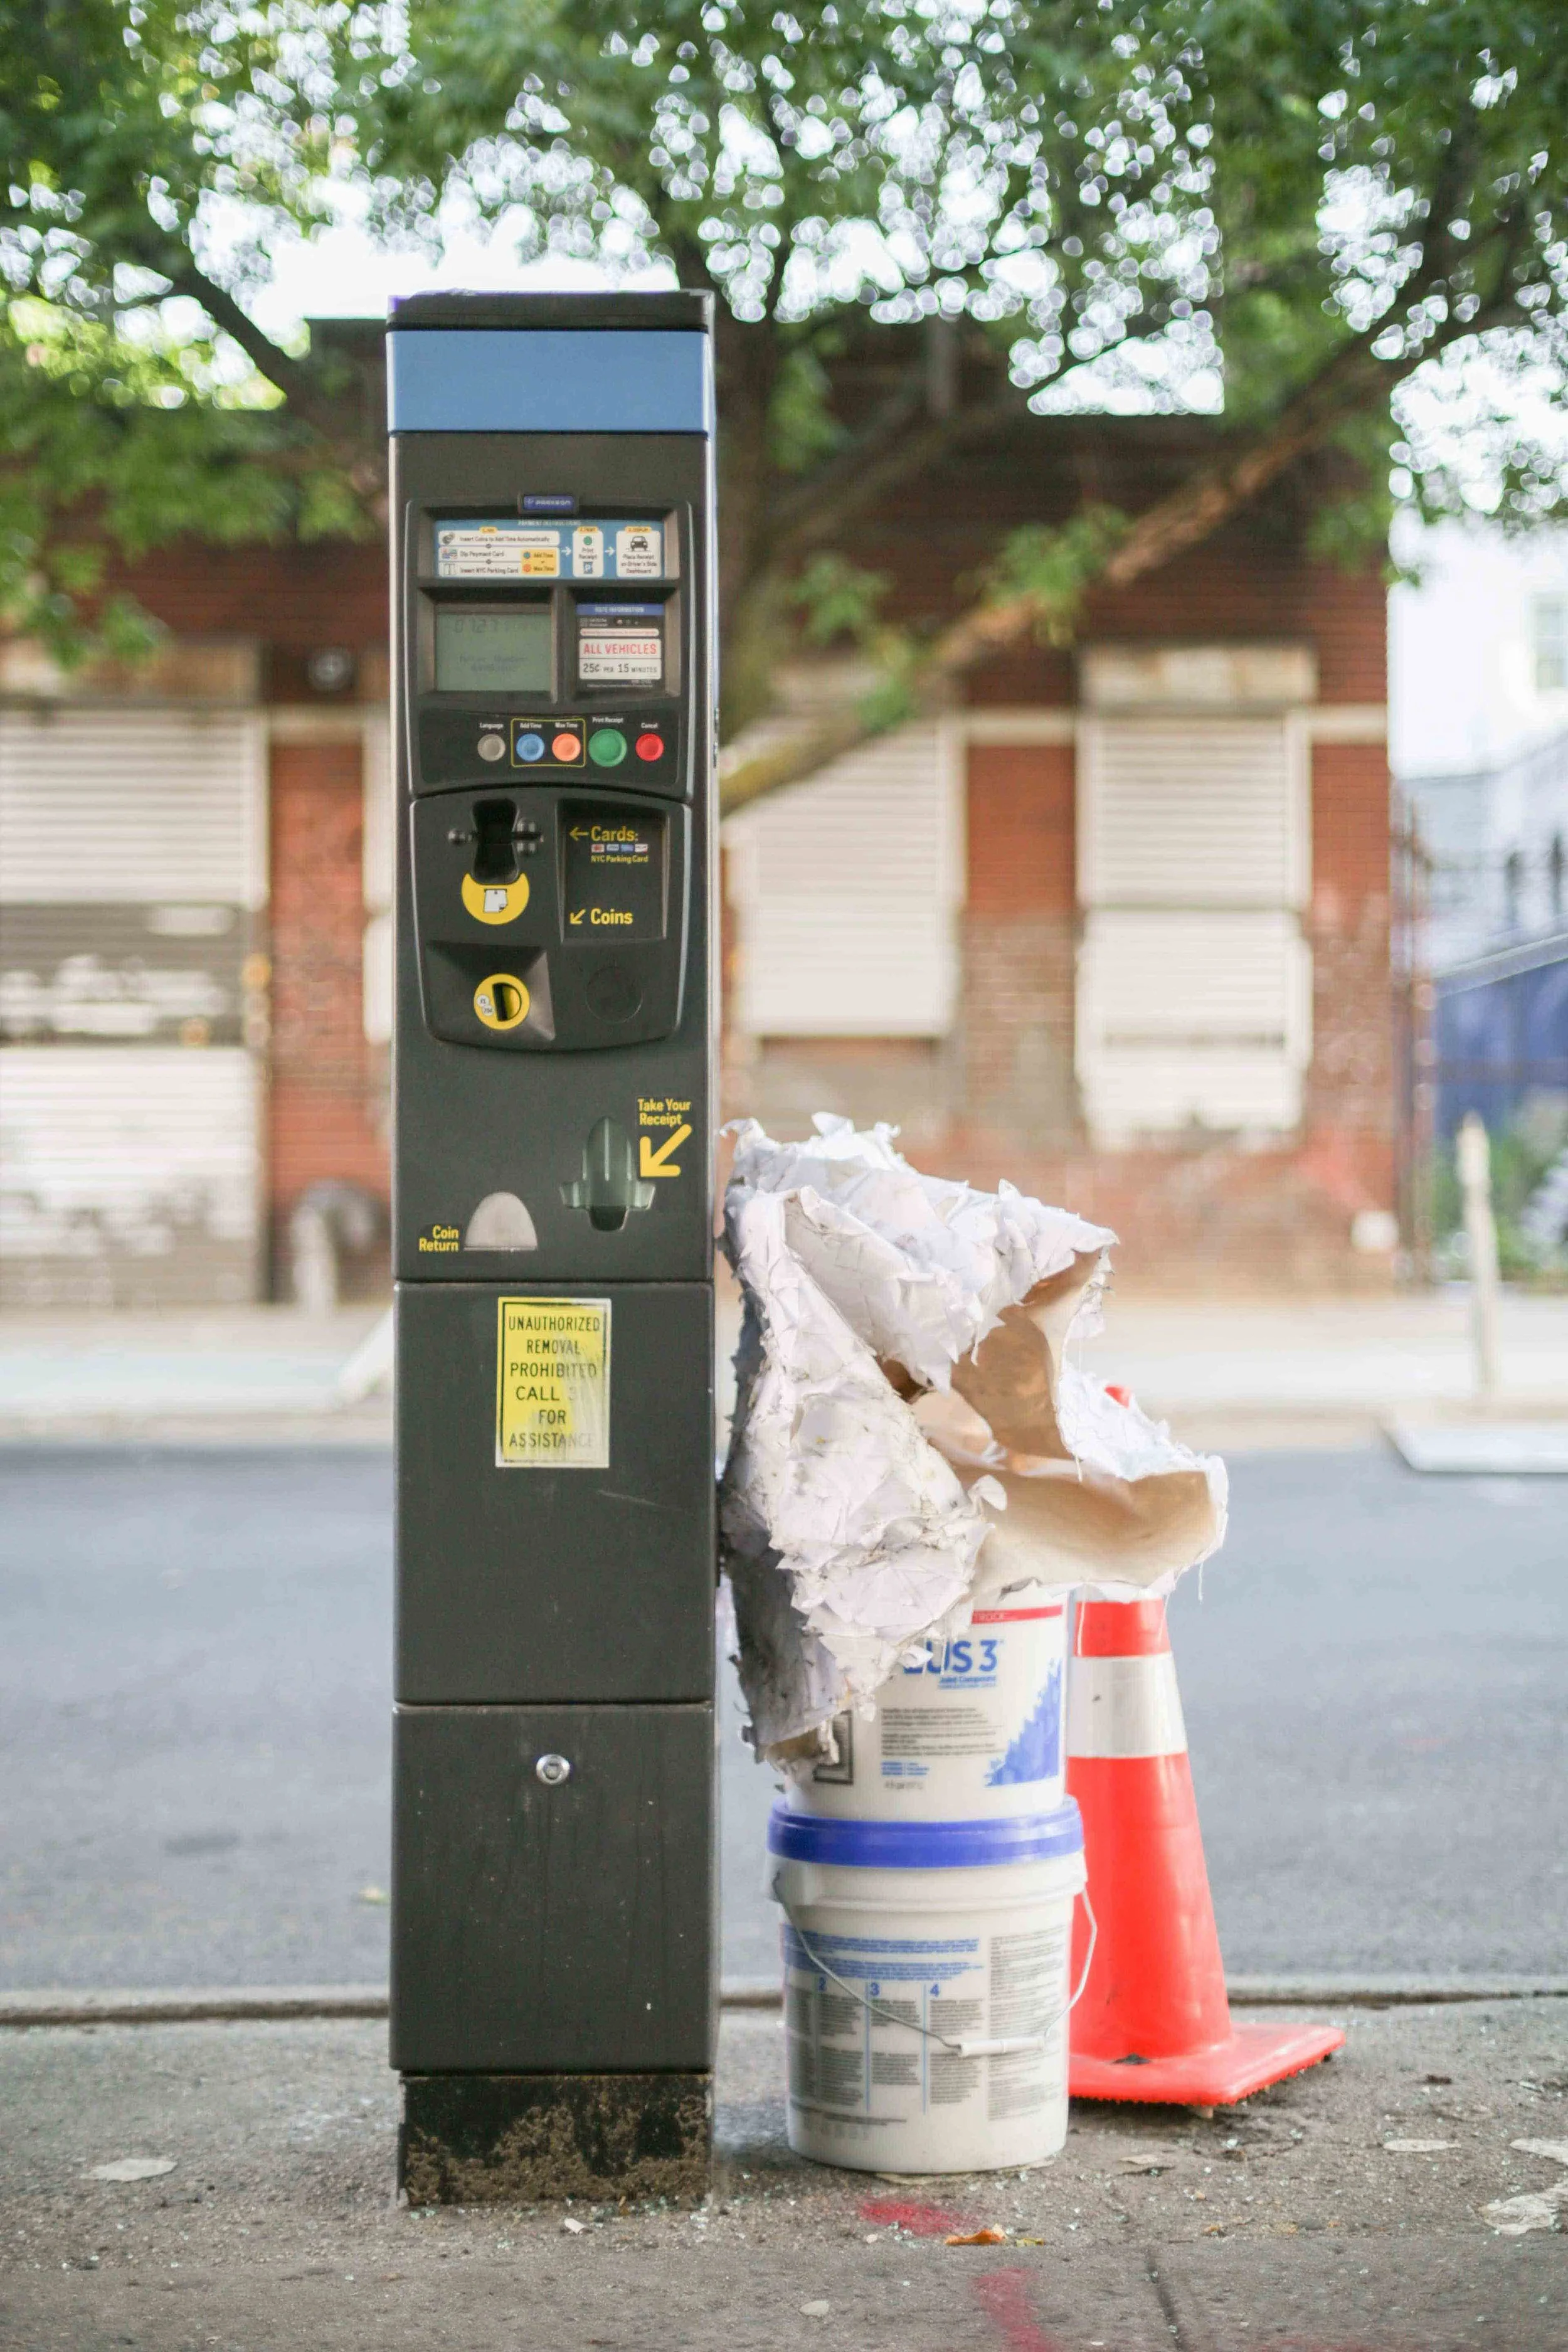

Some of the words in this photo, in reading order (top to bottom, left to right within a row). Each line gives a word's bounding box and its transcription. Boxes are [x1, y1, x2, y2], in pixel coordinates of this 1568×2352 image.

[487, 566, 506, 575] Parking
[583, 643, 602, 655] ALL
[604, 643, 657, 655] VEHICLES
[583, 663, 600, 673] 25¢
[618, 663, 629, 673] 15
[590, 825, 638, 842] Cards:
[590, 854, 605, 862] NYC
[606, 854, 632, 864] Parking
[632, 854, 649, 862] Card
[590, 908, 633, 924] Coins
[637, 1098, 665, 1111] Take
[665, 1098, 691, 1111] Your
[639, 1112, 682, 1128] Receipt
[433, 1224, 459, 1239] Coin
[419, 1237, 459, 1252] Return
[509, 1315, 600, 1331] UNAUTHORIZED
[526, 1339, 581, 1354] REMOVAL
[510, 1362, 597, 1378] PROHIBITED
[516, 1385, 561, 1401] CALL
[538, 1409, 566, 1424] FOR
[979, 1638, 999, 1672] 3
[870, 1982, 880, 1996] 3
[930, 1984, 940, 1997] 4
